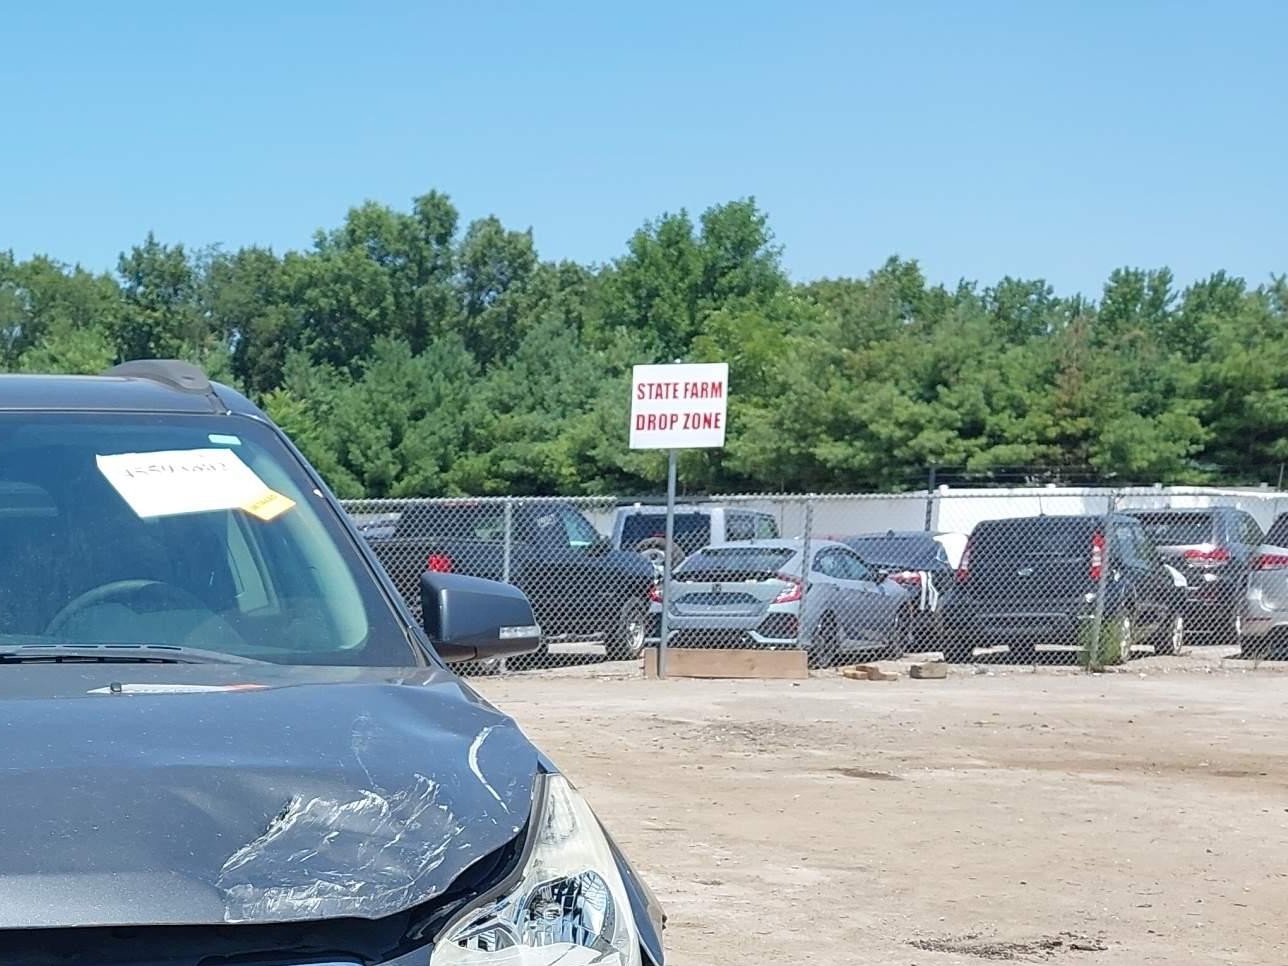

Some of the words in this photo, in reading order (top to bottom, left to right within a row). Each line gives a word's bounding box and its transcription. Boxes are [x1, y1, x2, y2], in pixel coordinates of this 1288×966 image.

[636, 382, 679, 400] STATE
[683, 381, 723, 399] FARM
[635, 413, 679, 431] DROP
[682, 412, 721, 430] ZONE
